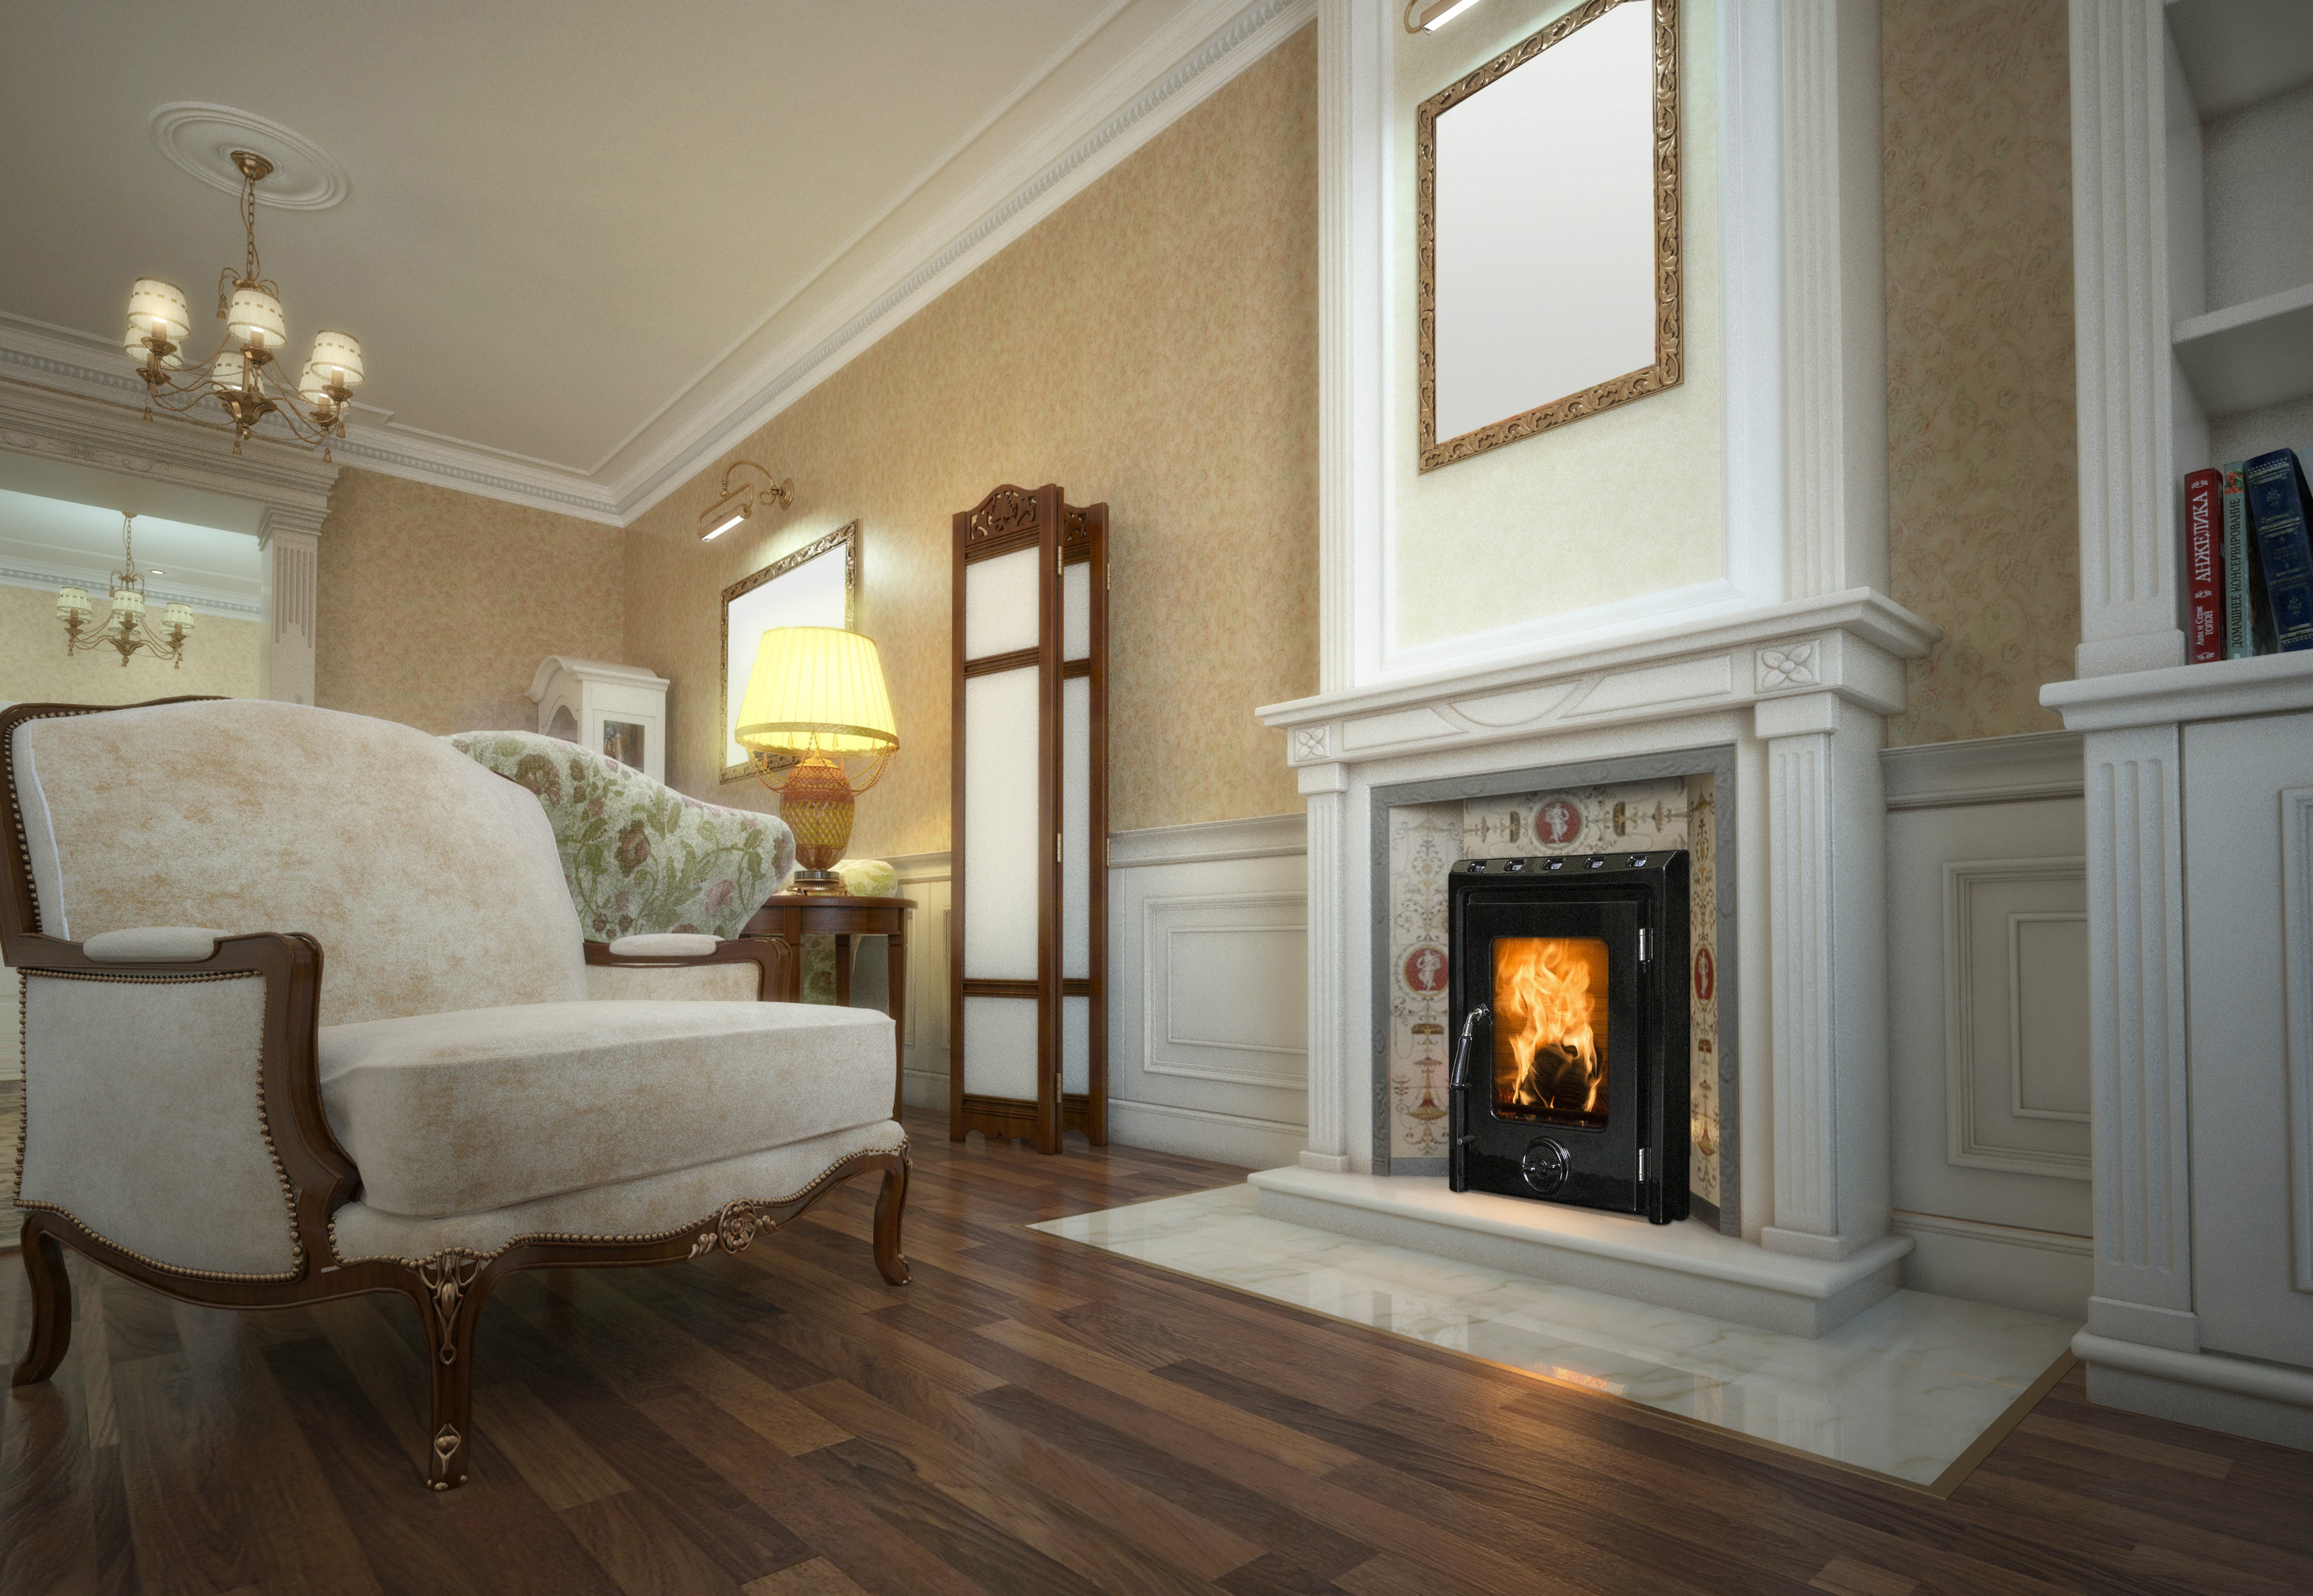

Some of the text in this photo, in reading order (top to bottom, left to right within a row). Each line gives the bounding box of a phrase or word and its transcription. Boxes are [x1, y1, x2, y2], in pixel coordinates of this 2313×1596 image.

[2193, 492, 2211, 582] АНЖЕЛИКА
[2230, 498, 2242, 648] ДОМАШНЕЕ КОНСЕРВИРОВАНИЕ
[2196, 605, 2204, 624] Серж
[2205, 611, 2214, 635] ГОЛОН
[2196, 631, 2204, 645] Анн
